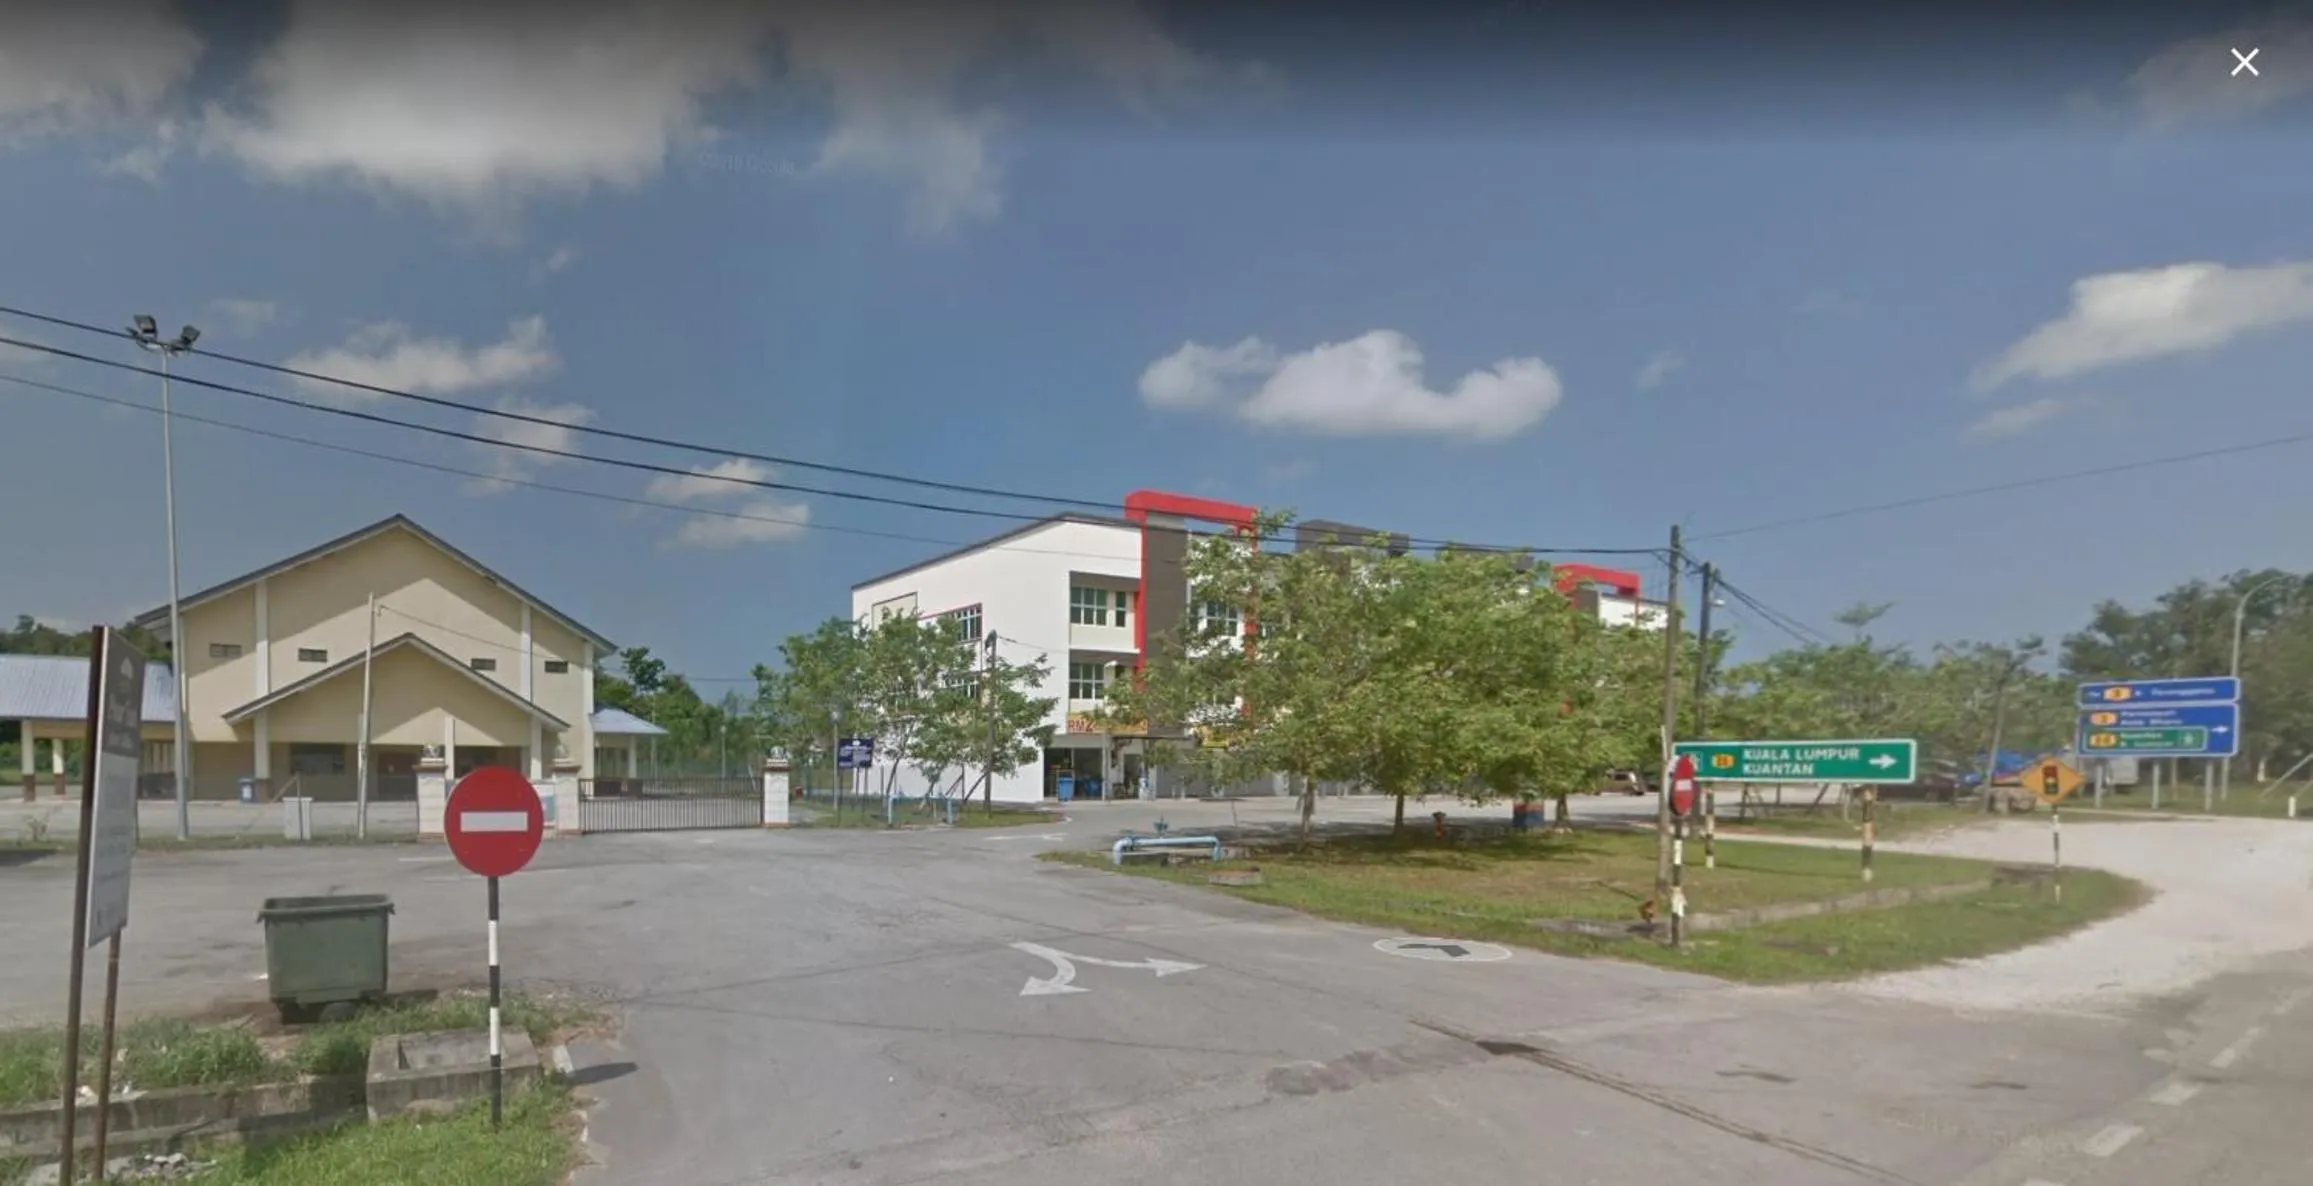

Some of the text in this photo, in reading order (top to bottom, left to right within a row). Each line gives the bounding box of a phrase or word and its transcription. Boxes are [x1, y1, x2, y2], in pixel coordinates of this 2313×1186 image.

[1743, 747, 1860, 760] KUALA LUMPUR
[1743, 763, 1814, 776] KUANTAN
